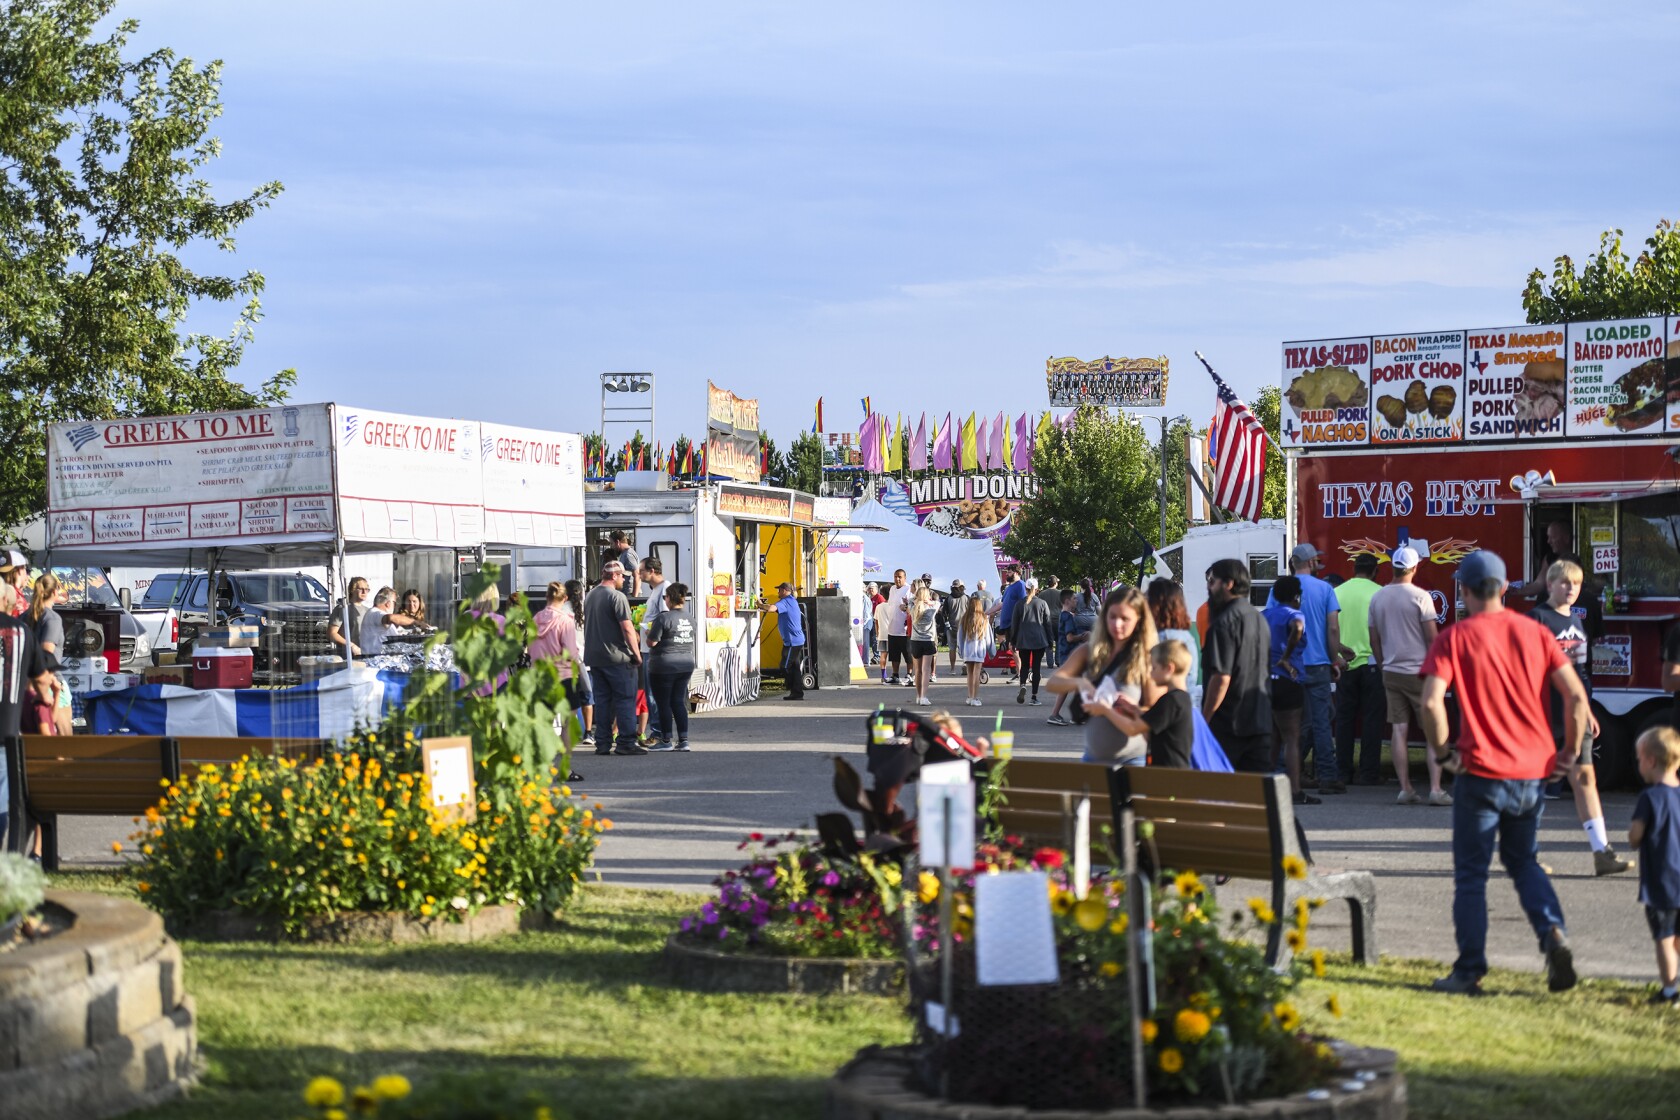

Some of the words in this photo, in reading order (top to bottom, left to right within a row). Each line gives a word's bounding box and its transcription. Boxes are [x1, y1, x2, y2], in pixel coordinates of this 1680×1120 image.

[1469, 334, 1506, 349] TEXAS
[1508, 331, 1564, 348] Mesquite
[1586, 324, 1651, 342] LOADED
[1374, 337, 1416, 354] BACON
[1417, 334, 1462, 344] WRAPPED
[1574, 342, 1613, 361] BAKED
[1616, 337, 1662, 360] POTATO
[1285, 343, 1369, 369] TEXAS-SIZED
[1394, 354, 1423, 362] CENTER
[1494, 349, 1556, 365] Smoked
[1372, 363, 1416, 384] PORK
[1418, 361, 1463, 380] CHOP
[1574, 365, 1603, 374] BUTTER
[1469, 376, 1525, 396] PULLED
[1574, 375, 1603, 384] CHEESE
[1574, 386, 1601, 395] BACON
[1603, 384, 1621, 393] BITS
[1574, 396, 1596, 405] SOUR
[1598, 394, 1628, 404] CREAM
[1472, 399, 1515, 417] PORK
[1301, 409, 1334, 424] PULLED
[1337, 407, 1368, 422] PORK
[1576, 408, 1606, 424] HUGE
[103, 420, 190, 445] GREEK
[195, 417, 229, 438] TO
[236, 413, 274, 436] ME
[1302, 423, 1367, 444] NACHOS
[1380, 428, 1398, 440] ON
[1401, 427, 1412, 440] A
[1415, 426, 1452, 439] STICK
[1469, 418, 1560, 435] SANDWICH
[363, 421, 412, 449] GREEK
[414, 426, 432, 450] TO
[434, 429, 457, 452] ME
[200, 446, 233, 455] SEAFOOD
[233, 442, 283, 452] COMBINATION
[284, 440, 314, 448] PLATTER
[496, 438, 528, 462] GREEK
[530, 441, 543, 464] TO
[544, 444, 561, 466] ME
[264, 453, 293, 461] SAUTEED
[59, 464, 91, 472] CHICKEN
[117, 461, 144, 469] SERVED
[201, 467, 217, 475] RICE
[218, 466, 236, 474] PILAF
[251, 463, 273, 471] GREEK
[93, 471, 124, 479] PLATTER
[228, 477, 244, 485] PITA
[910, 475, 966, 505] MINI
[246, 501, 278, 509] SEAFOOD
[293, 500, 325, 508] CEVICHE
[1318, 481, 1414, 518] TEXAS
[1426, 479, 1501, 517] BEST
[147, 510, 186, 519] MAHI-MAHI
[102, 522, 134, 530] SAUSAGE
[193, 521, 236, 529] JAMBALAYA
[247, 518, 276, 526] SHRIMP
[96, 531, 140, 539] LOUKANIKO
[151, 528, 181, 536] SALMON
[1596, 560, 1619, 570] ONL
